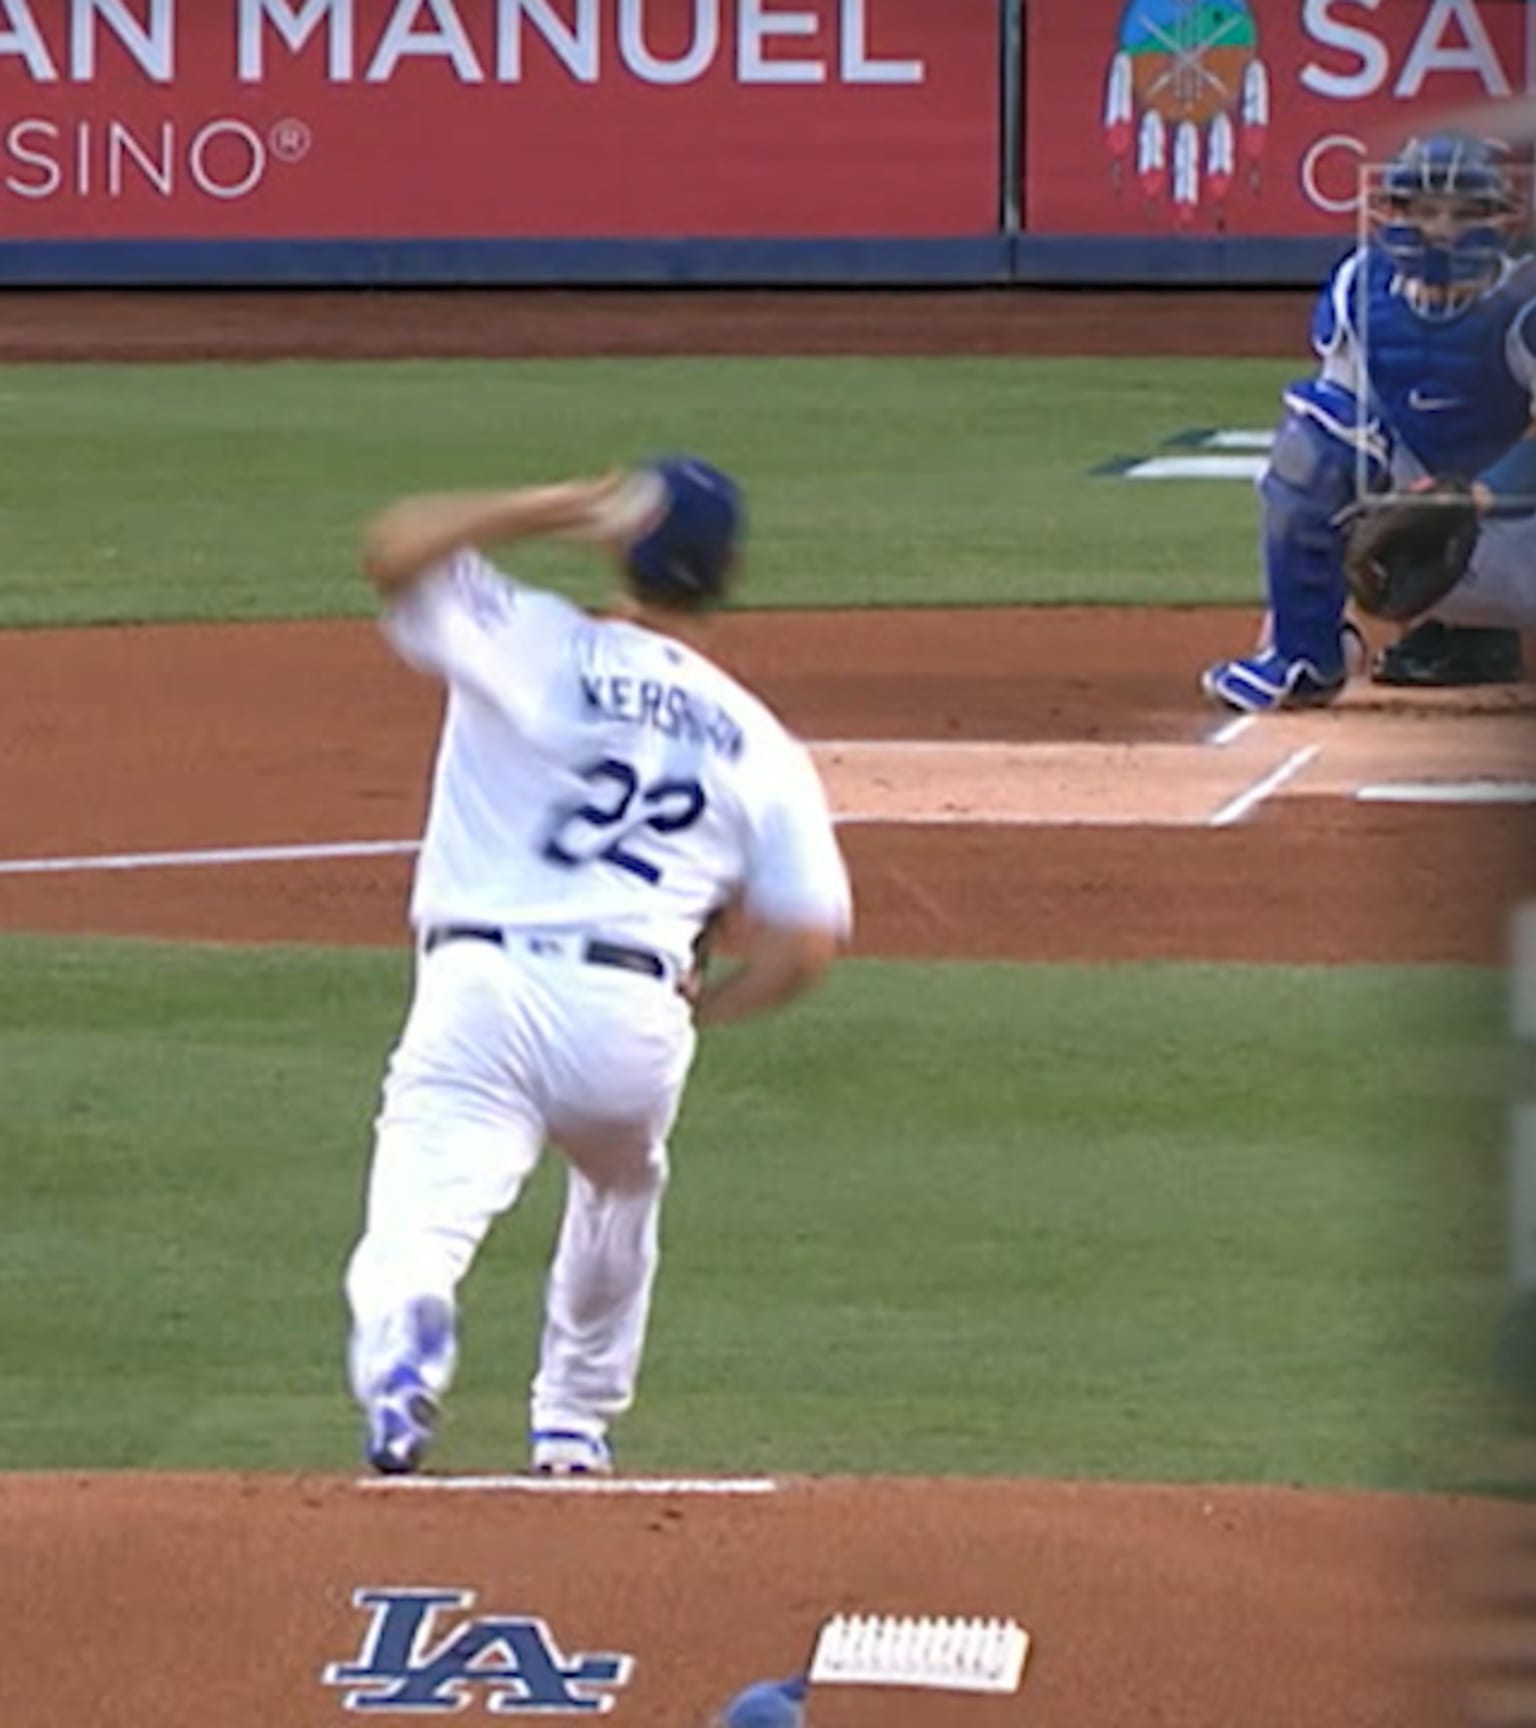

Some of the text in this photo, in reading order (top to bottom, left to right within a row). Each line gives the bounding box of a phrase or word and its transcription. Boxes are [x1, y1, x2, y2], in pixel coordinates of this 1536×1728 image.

[237, 0, 926, 82] MANUEL
[543, 760, 708, 885] 22
[322, 1588, 634, 1714] LA
